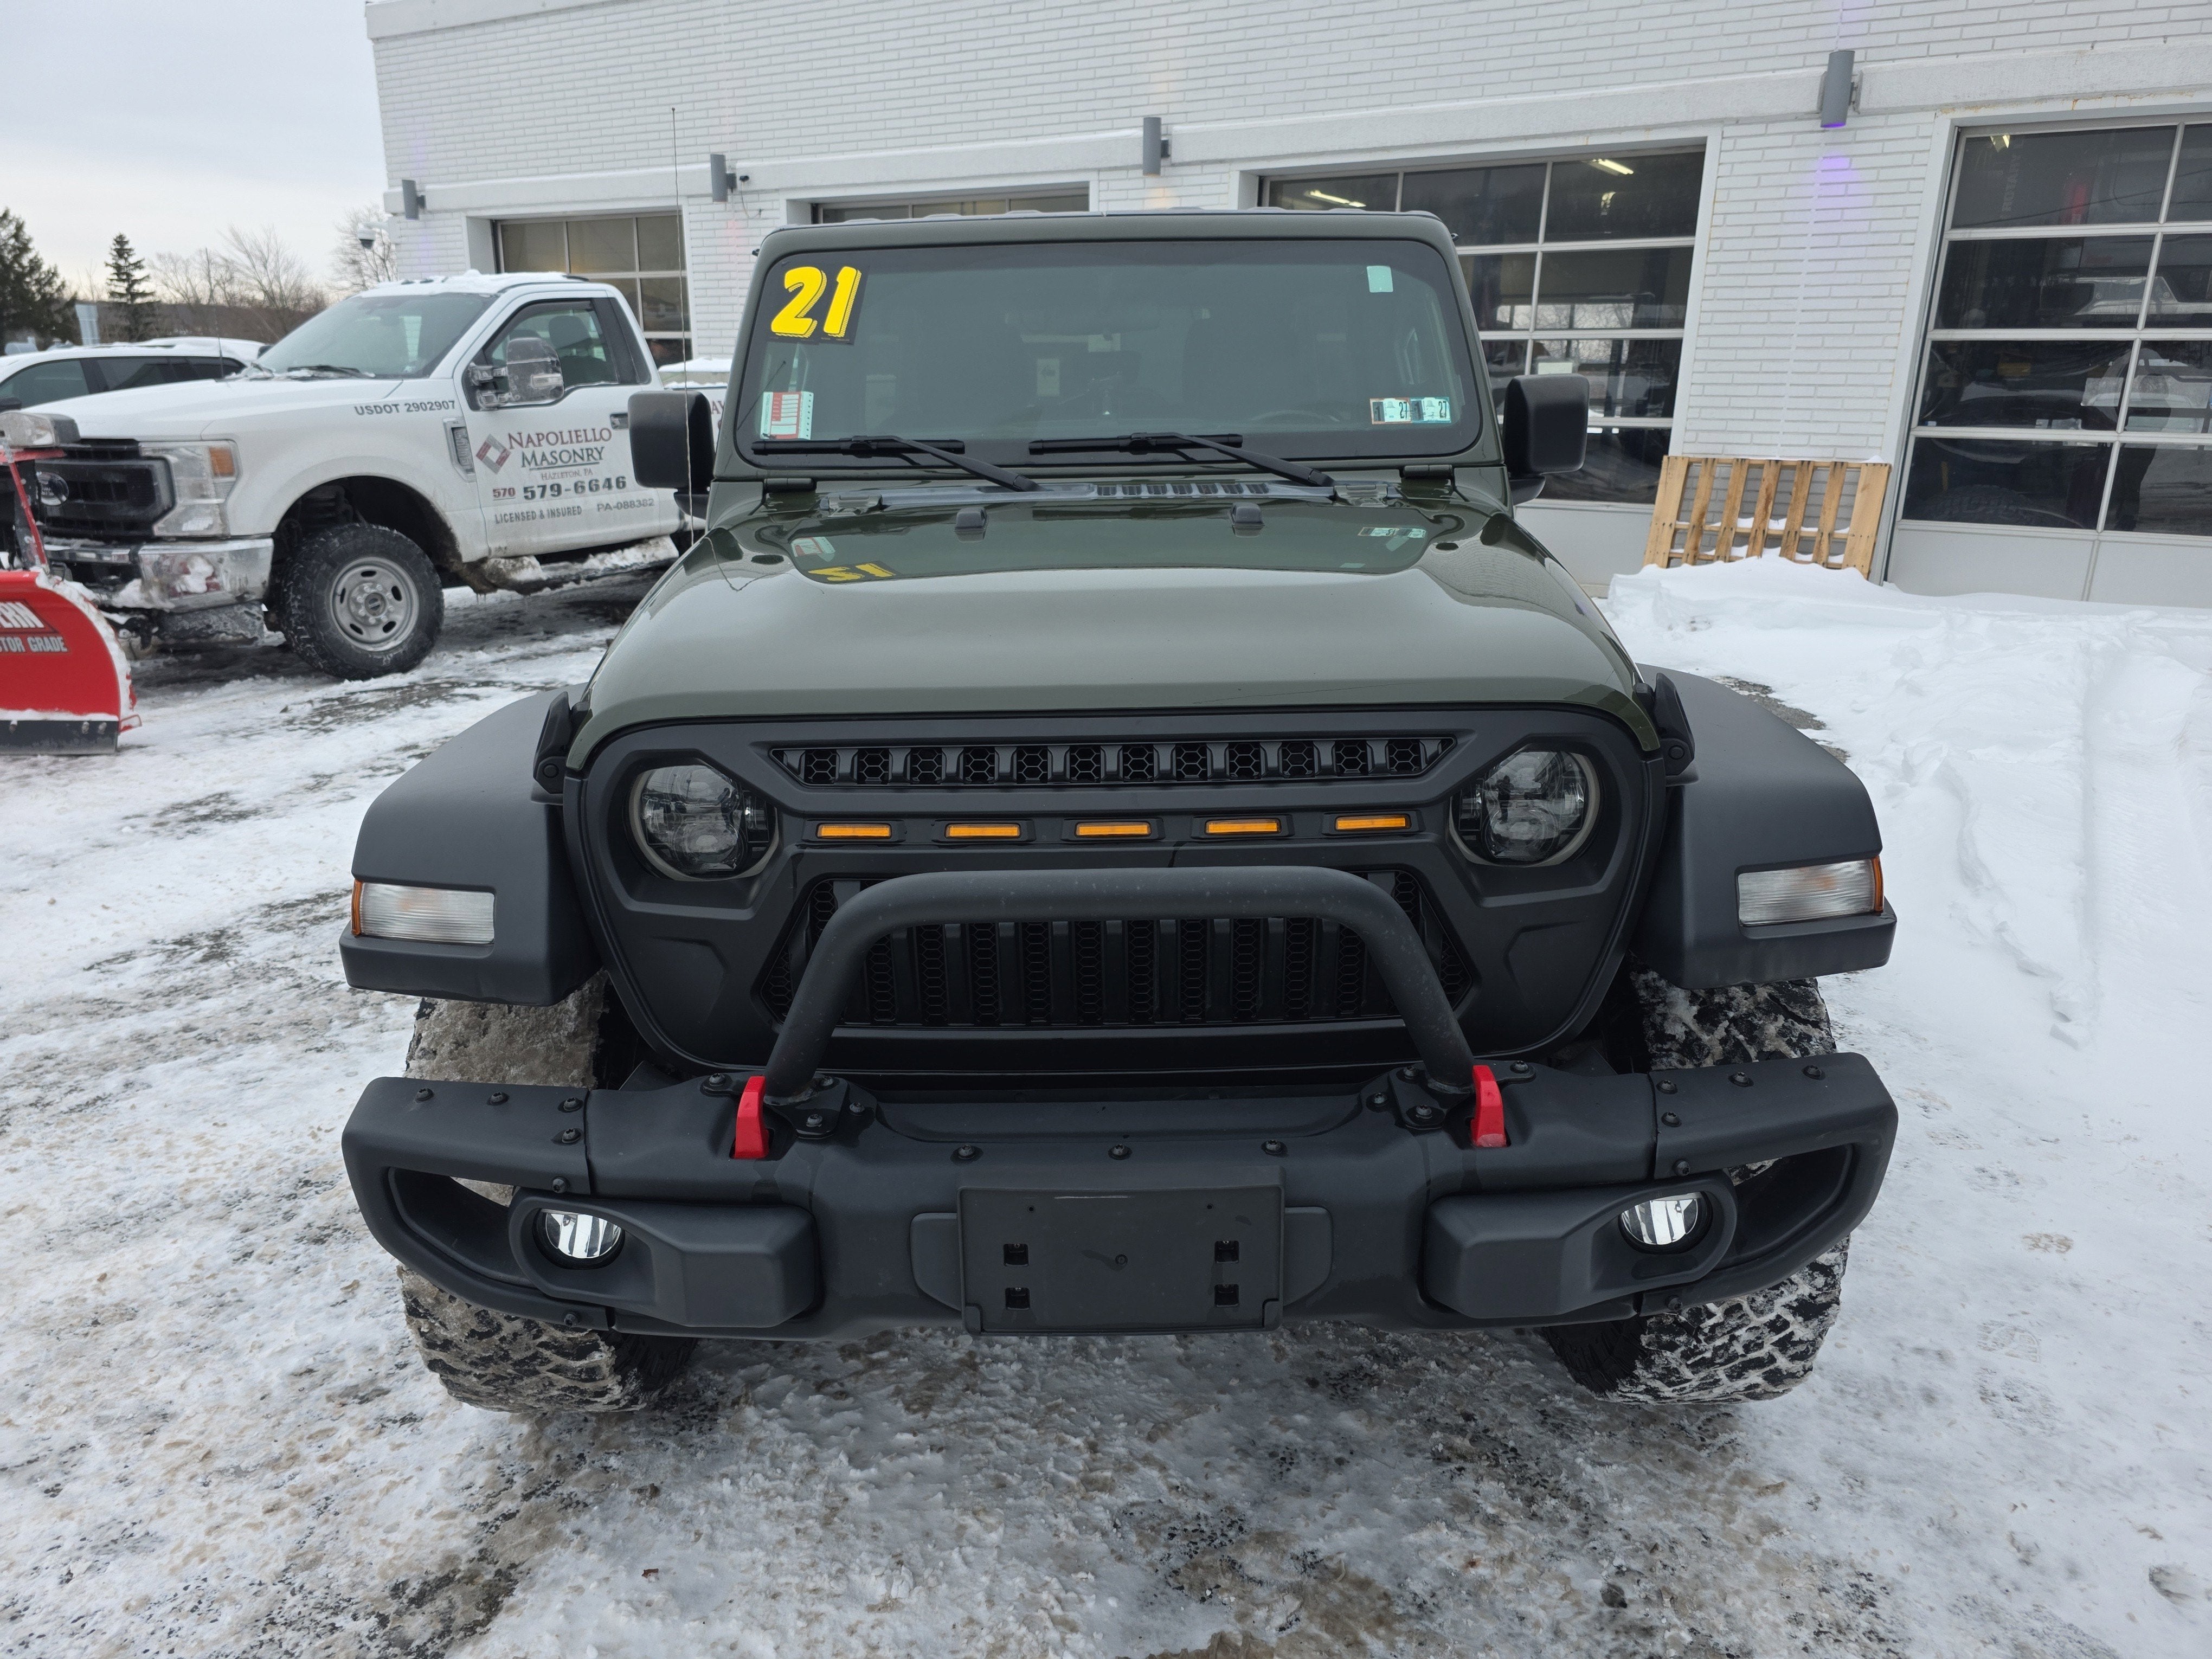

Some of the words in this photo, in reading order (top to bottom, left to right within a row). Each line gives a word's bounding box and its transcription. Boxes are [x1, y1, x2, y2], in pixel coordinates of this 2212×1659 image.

[771, 266, 862, 338] 21
[354, 404, 400, 415] USDOT
[404, 400, 455, 413] 2902907
[1438, 401, 1447, 419] 27
[507, 428, 612, 449] NAPOLIELLO
[521, 446, 605, 468] MASONRY
[584, 468, 593, 476] PA
[493, 488, 516, 498] 570
[523, 476, 627, 500] 579-6646
[495, 511, 537, 524] LICENSED
[539, 510, 545, 519] &
[547, 505, 582, 519] INSURED
[27, 636, 68, 652] GRADE
